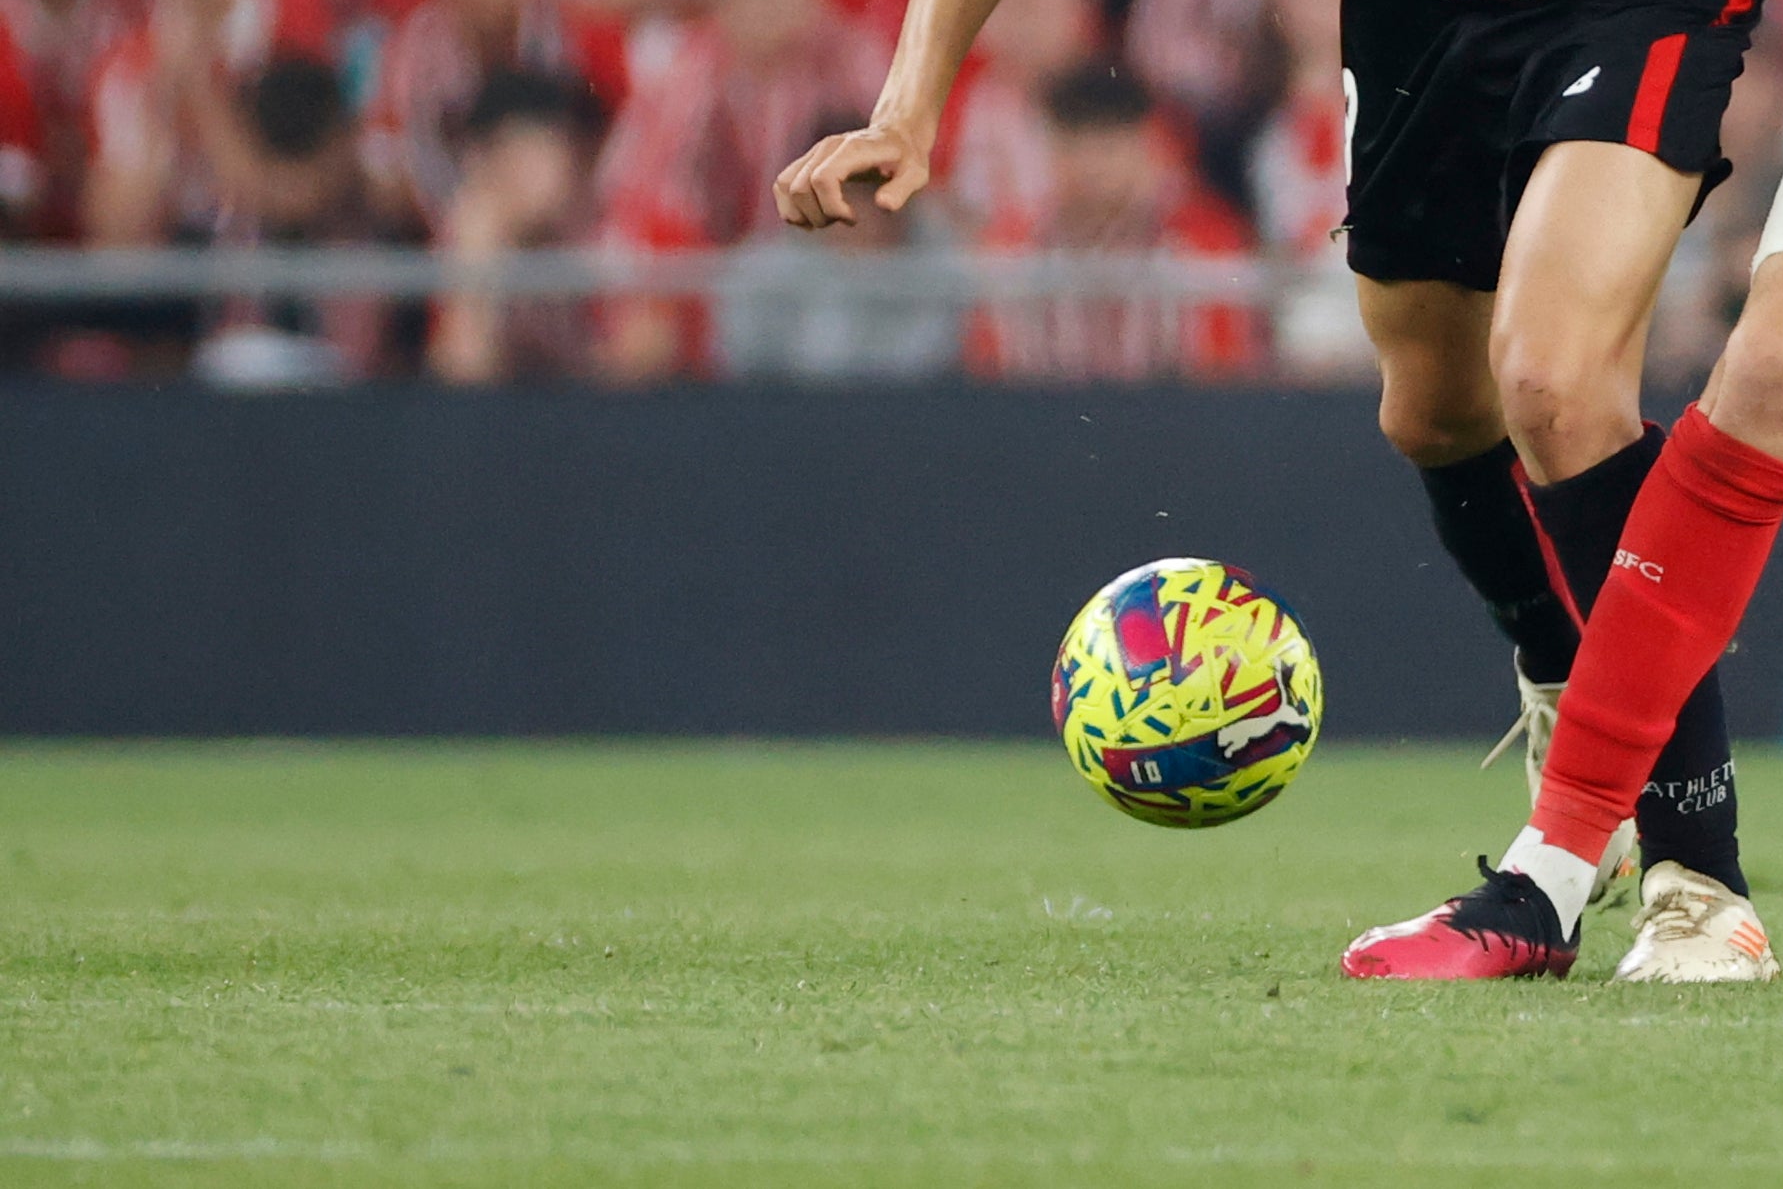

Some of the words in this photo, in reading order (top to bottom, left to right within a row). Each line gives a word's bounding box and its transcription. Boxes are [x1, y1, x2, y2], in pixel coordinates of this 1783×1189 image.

[1613, 549, 1664, 583] SFC
[1641, 758, 1735, 798] ATHLETI
[1677, 785, 1727, 814] CLUB
